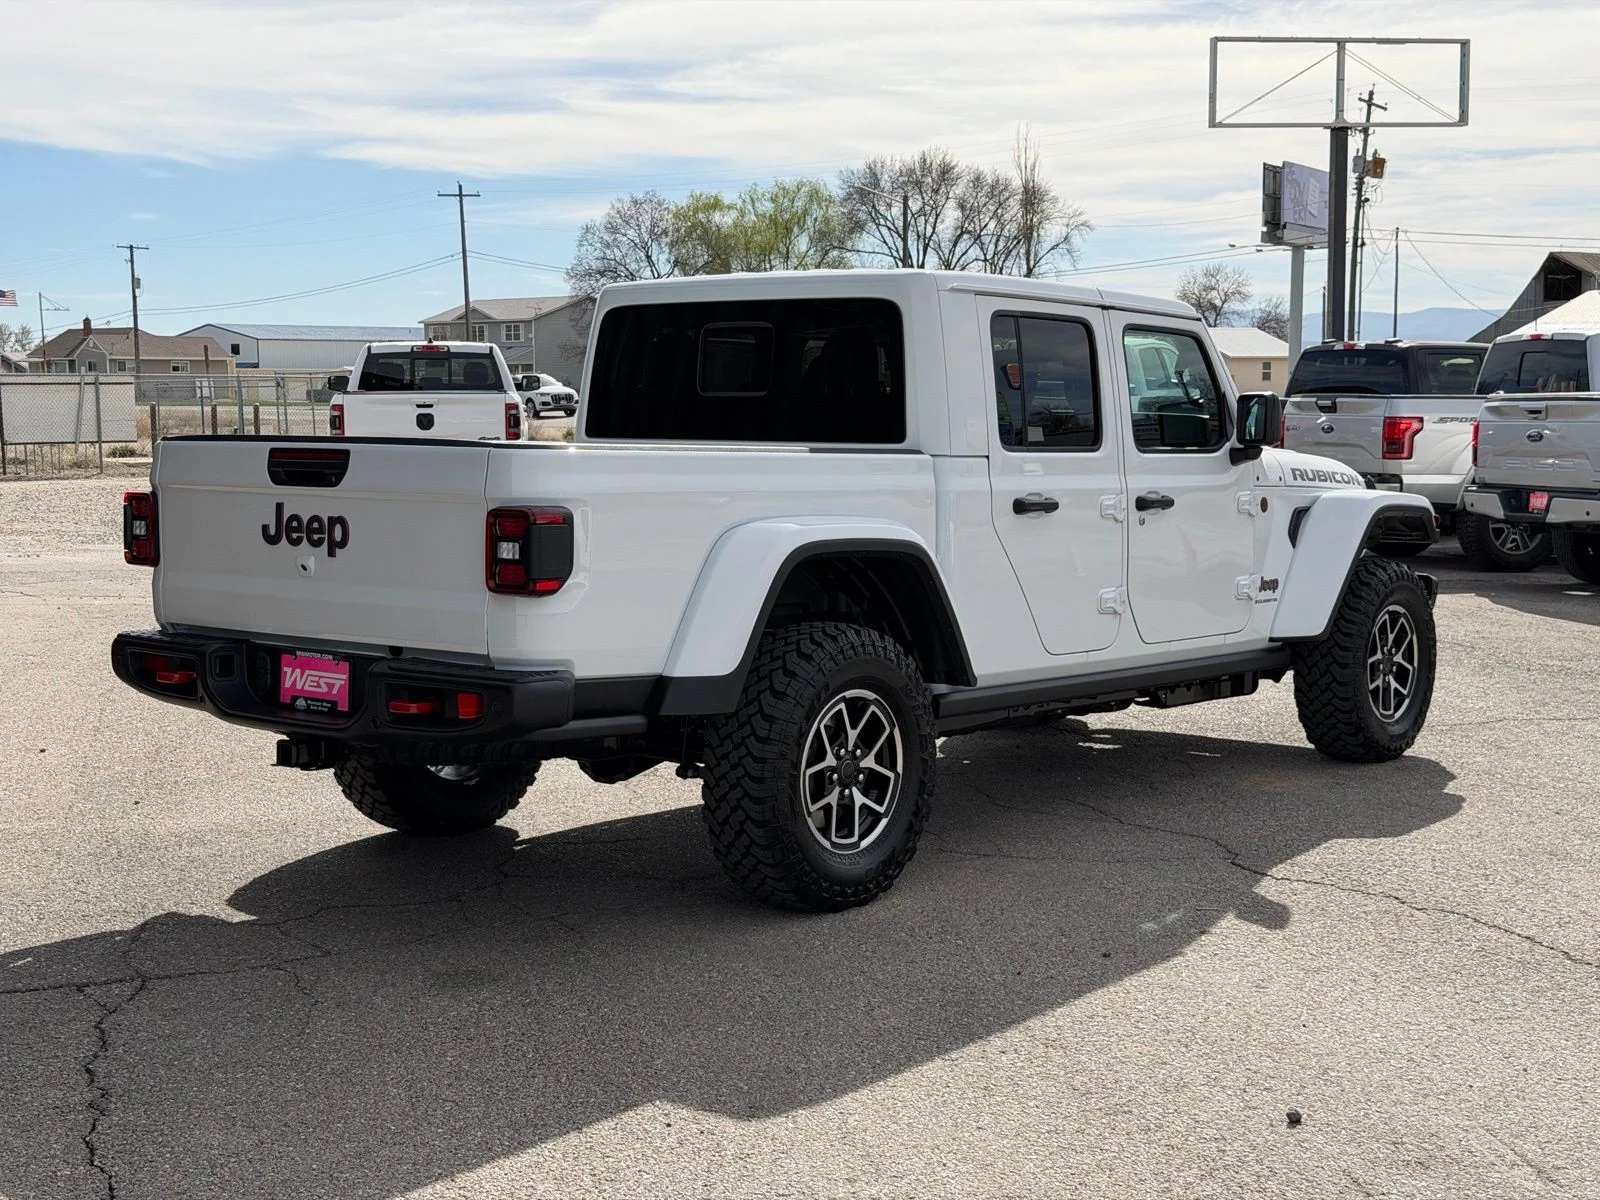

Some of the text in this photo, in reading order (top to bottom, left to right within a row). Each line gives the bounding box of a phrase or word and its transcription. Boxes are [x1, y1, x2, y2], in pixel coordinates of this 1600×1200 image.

[1432, 416, 1479, 424] SPOR
[1290, 467, 1362, 486] RUBICON
[261, 502, 350, 558] Jeep
[1259, 576, 1279, 593] Jeep
[283, 666, 349, 695] WEST
